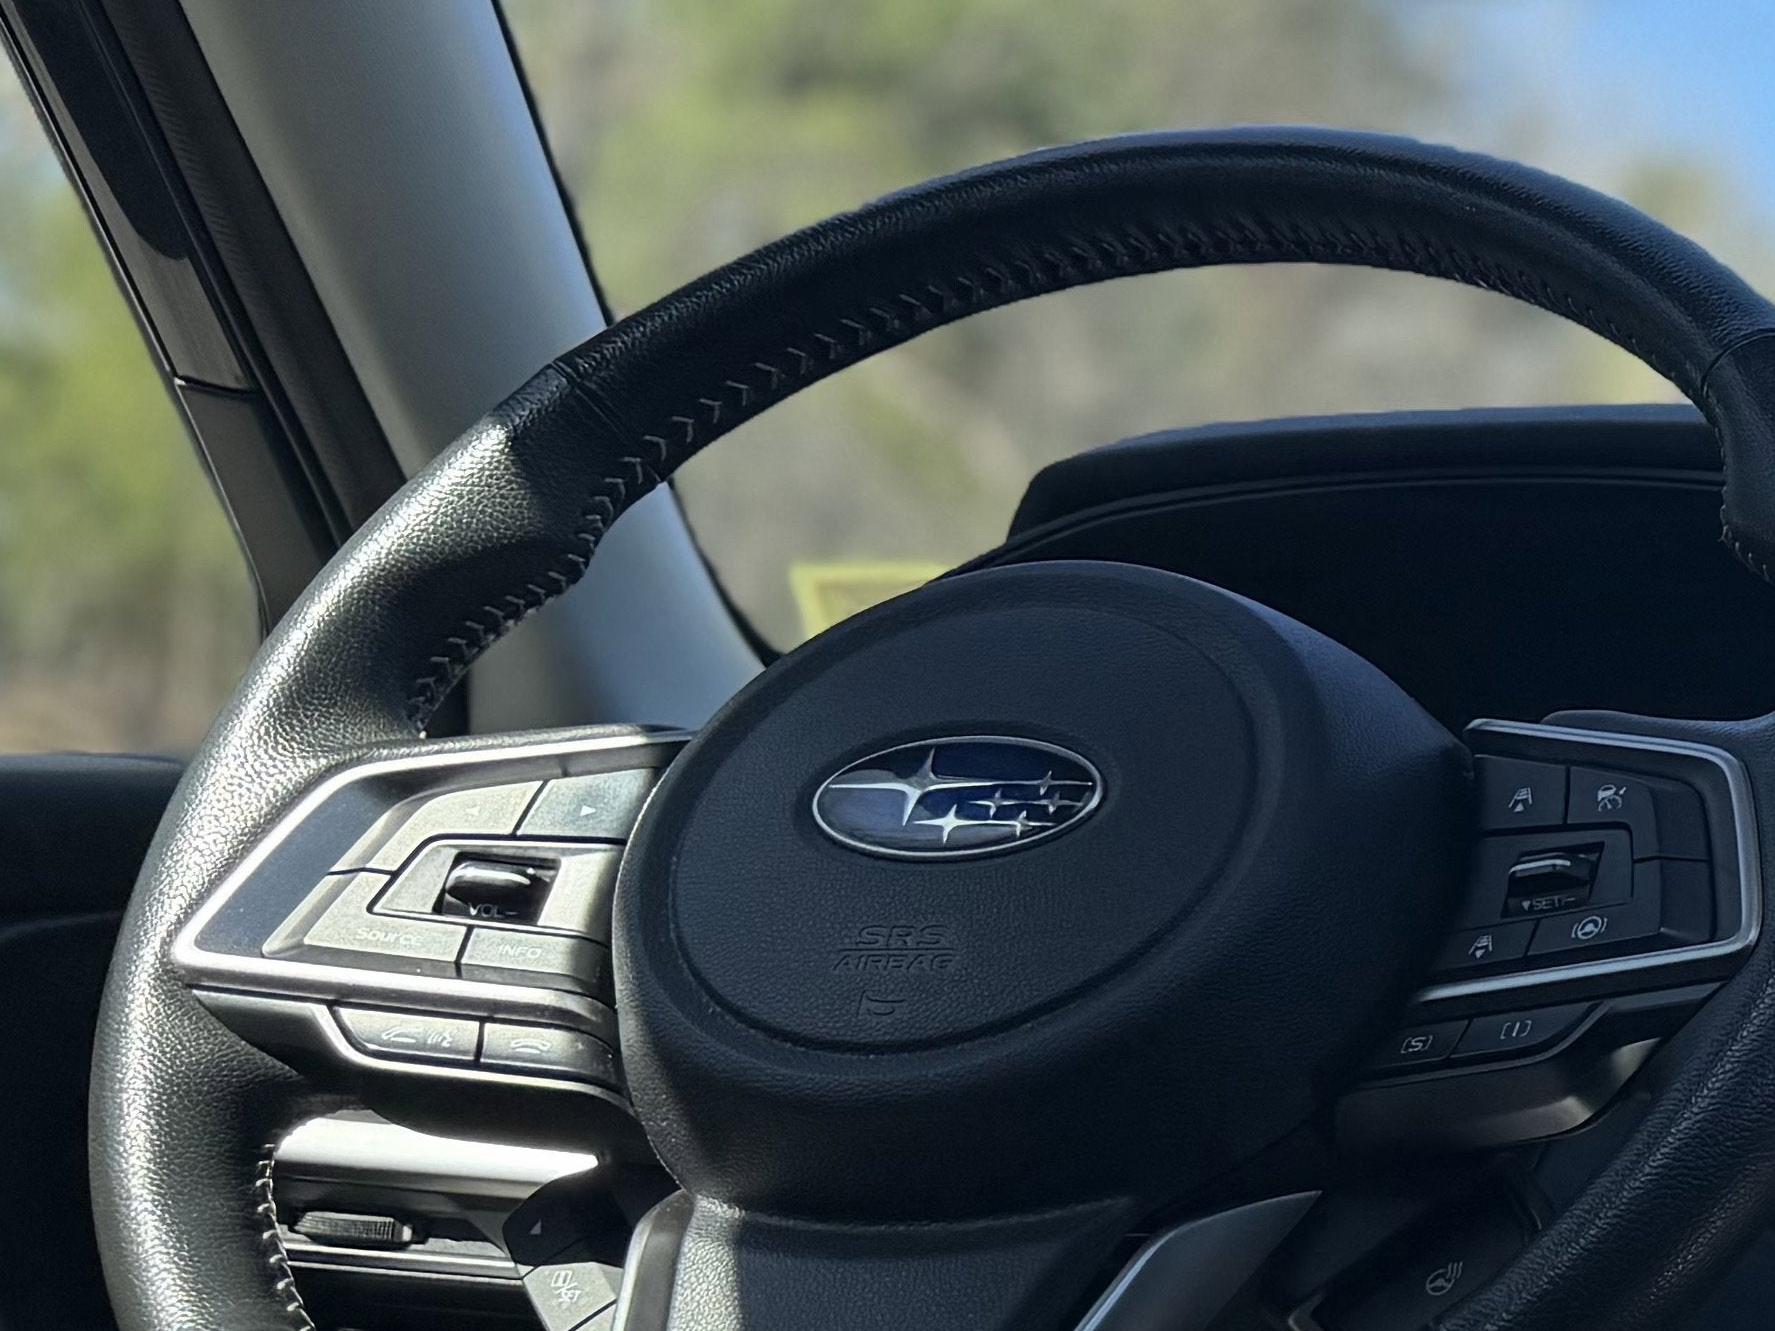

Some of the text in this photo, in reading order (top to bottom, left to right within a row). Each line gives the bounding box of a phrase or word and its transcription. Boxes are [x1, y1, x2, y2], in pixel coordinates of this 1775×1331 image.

[856, 925, 949, 947] SRS
[499, 943, 543, 959] INFO
[832, 954, 955, 971] AIRBAG
